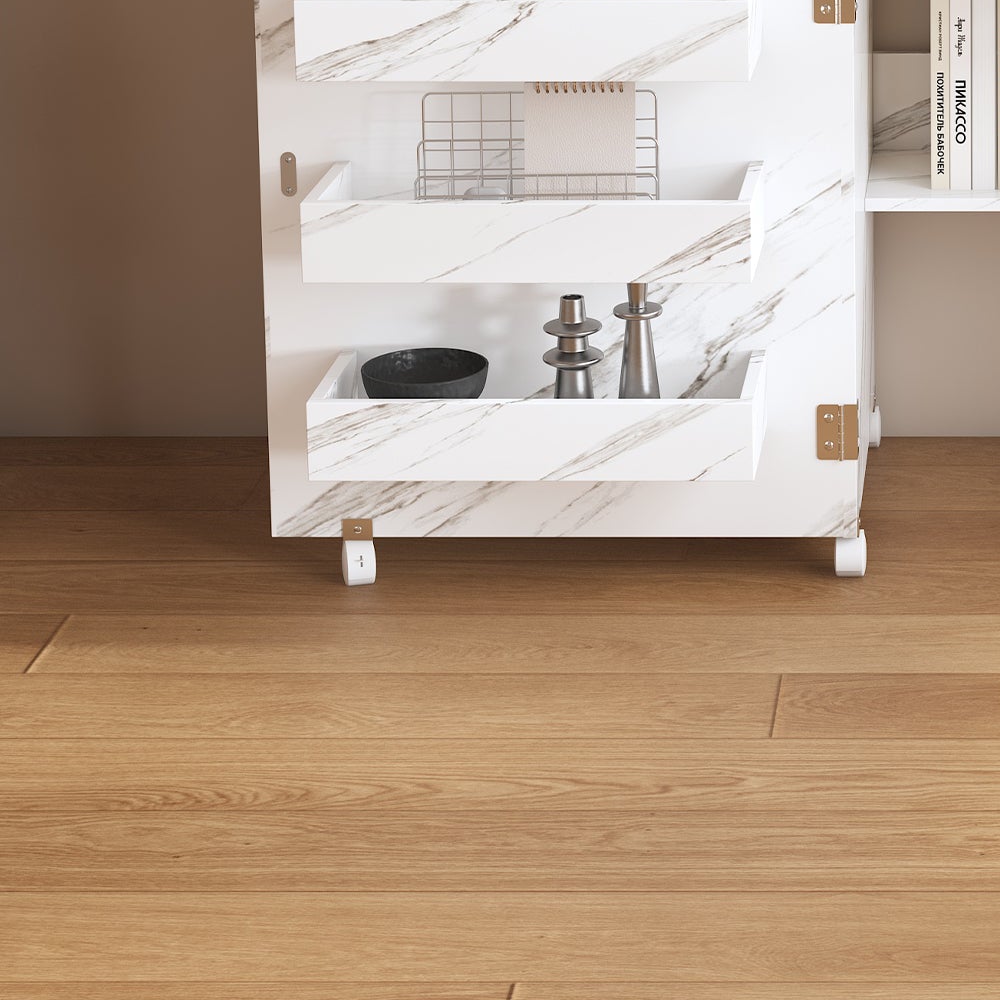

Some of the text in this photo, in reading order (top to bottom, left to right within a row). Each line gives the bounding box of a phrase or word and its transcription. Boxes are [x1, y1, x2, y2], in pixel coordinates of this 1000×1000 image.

[936, 72, 945, 175] ПОХИТИТЕЛЬ БАБОЧЕК
[954, 79, 967, 145] ПИКАССО
